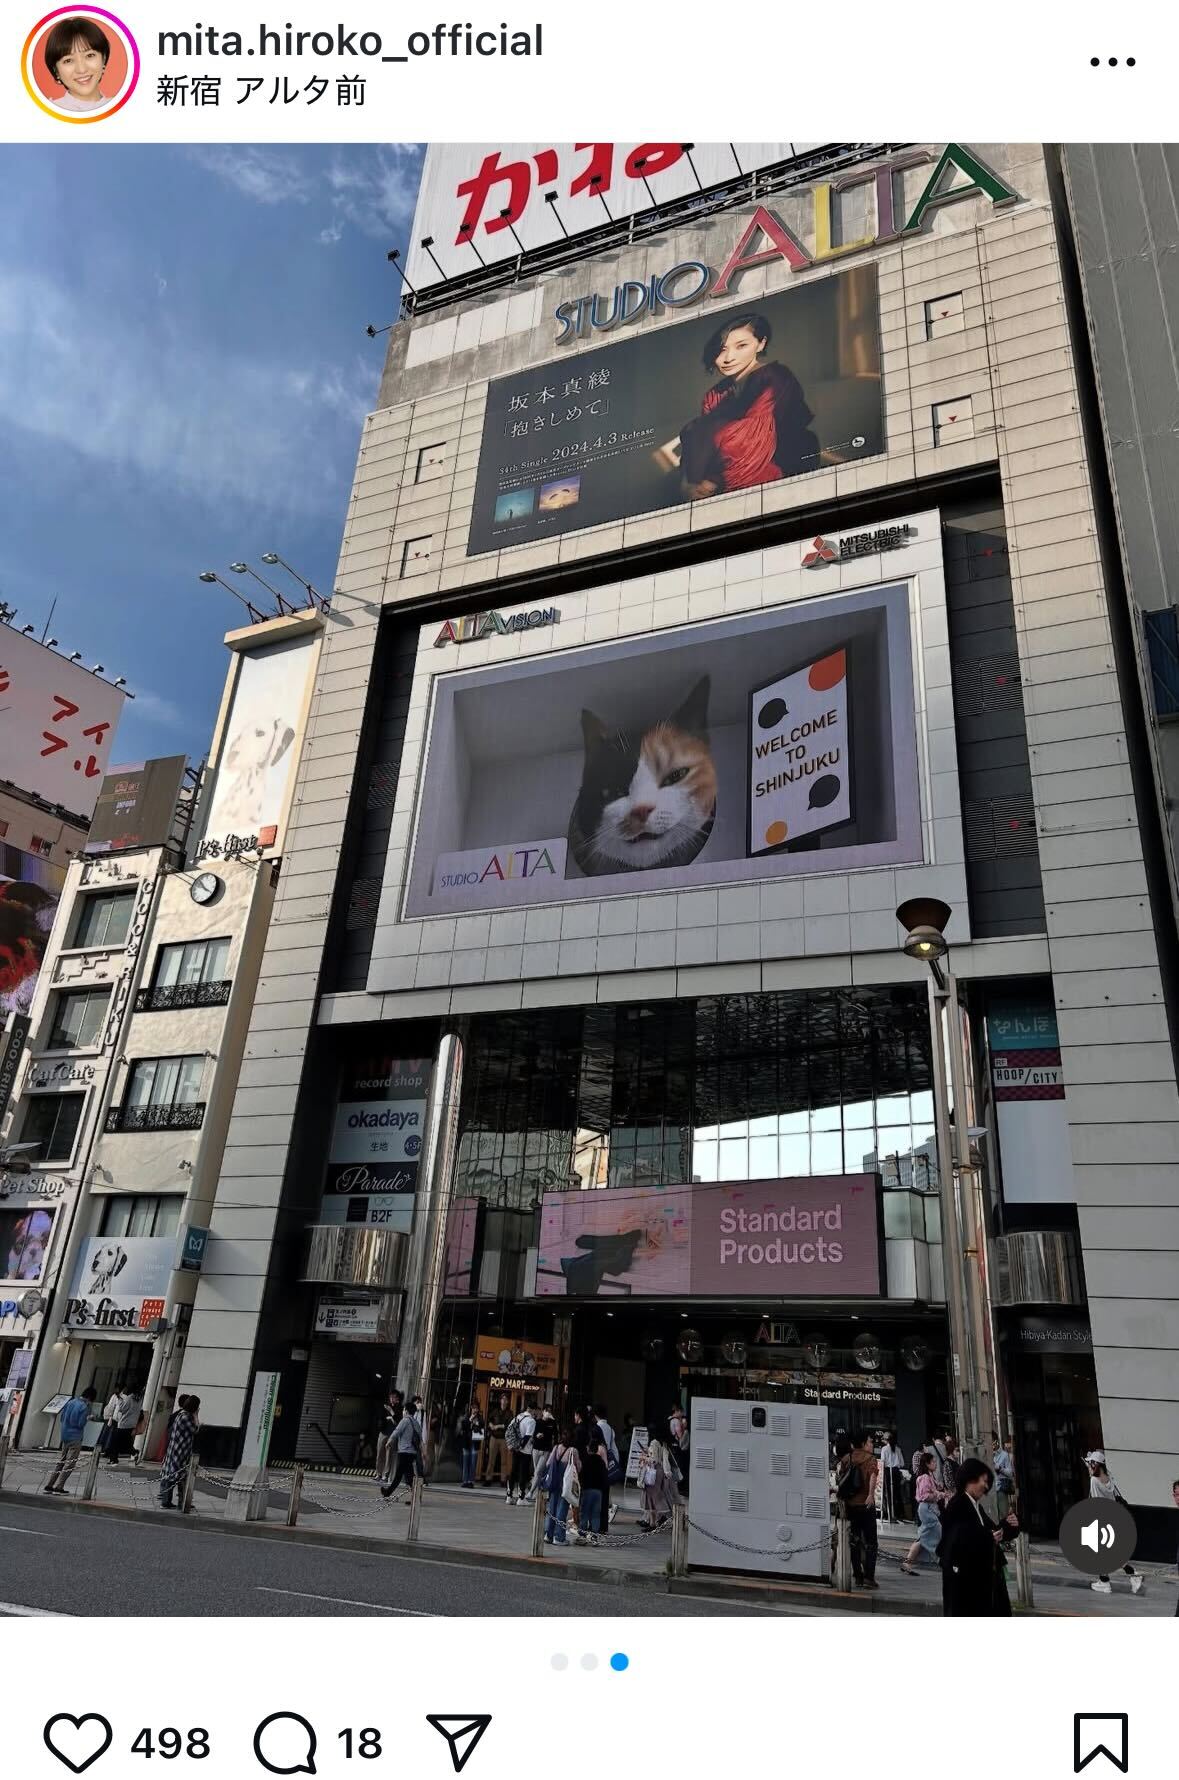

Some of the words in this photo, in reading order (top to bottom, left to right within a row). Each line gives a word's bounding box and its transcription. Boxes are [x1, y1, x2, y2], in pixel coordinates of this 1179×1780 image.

[555, 261, 710, 346] STUDIO
[709, 142, 1018, 298] ALTA
[507, 368, 612, 413] 坂本真綾
[521, 457, 549, 471] Single
[552, 432, 618, 462] 2024.4.3
[621, 427, 655, 443] Release
[839, 523, 909, 548] MITSUBISHI
[840, 536, 901, 558] ELECTRIC
[755, 708, 838, 760] WELCOME
[785, 744, 806, 764] TO
[755, 748, 840, 798] SHINJUKU
[441, 872, 479, 888] STUDIO
[479, 848, 556, 884] ALTA
[355, 1076, 391, 1089] record
[394, 1075, 423, 1088] shop
[347, 1109, 419, 1130] okadaya
[28, 1178, 65, 1195] Shop
[336, 1165, 407, 1192] Parade
[371, 1209, 392, 1222] B2F
[720, 1204, 842, 1233] Standard
[720, 1237, 843, 1264] Products
[63, 1298, 138, 1327] P's-first
[757, 1322, 800, 1343] ALTA
[490, 1377, 505, 1388] POP
[506, 1378, 526, 1390] MART
